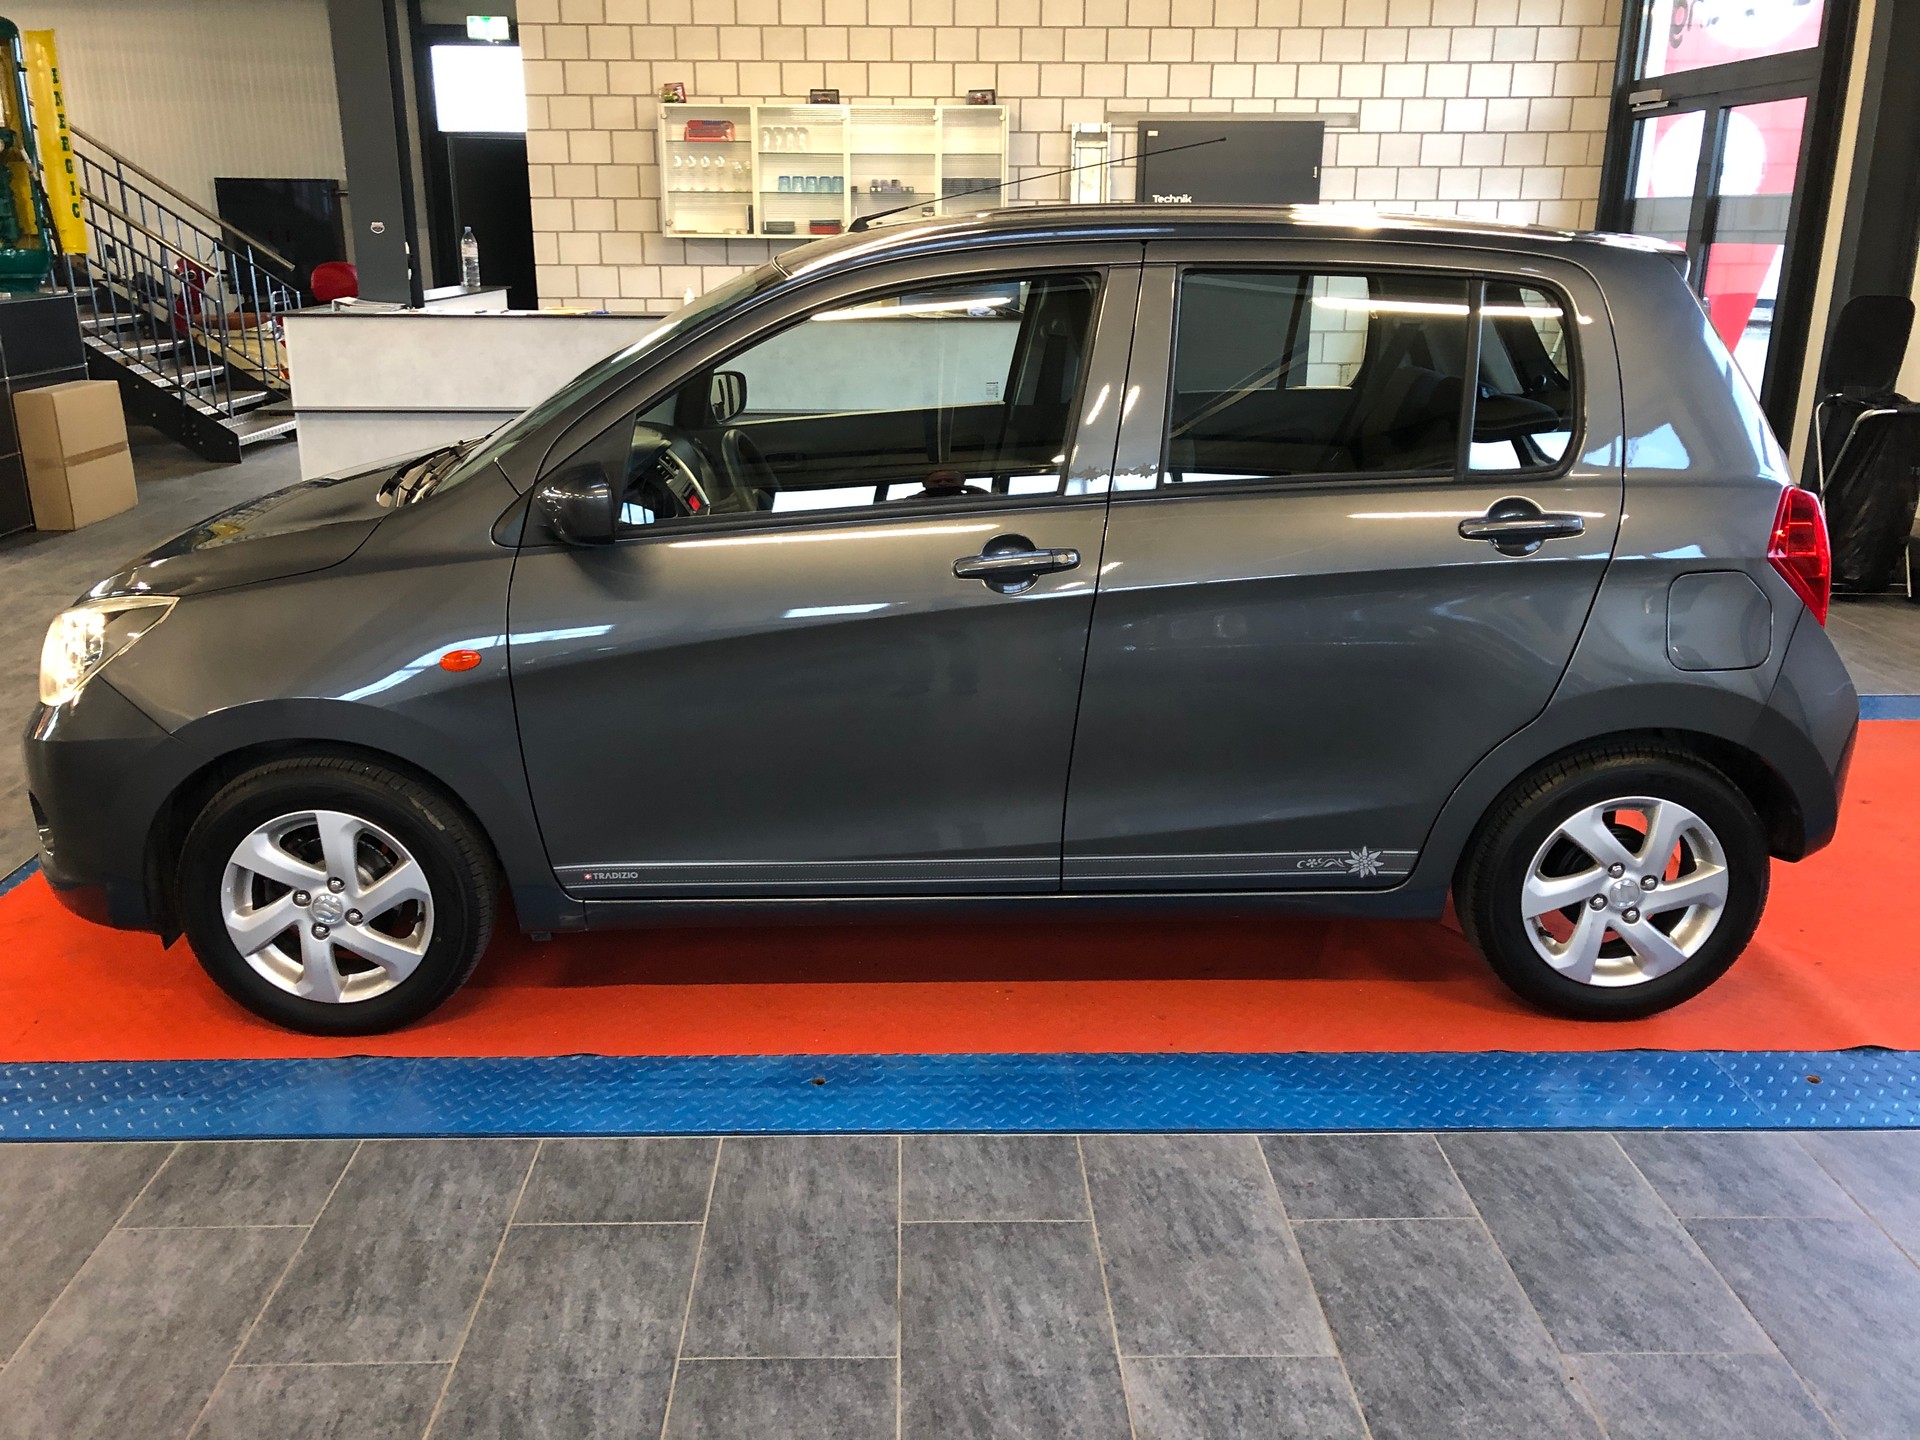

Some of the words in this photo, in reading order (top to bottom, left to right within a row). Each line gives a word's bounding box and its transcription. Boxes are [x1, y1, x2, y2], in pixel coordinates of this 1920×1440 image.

[51, 68, 80, 218] ENERGIC
[1152, 194, 1192, 203] Technik
[593, 871, 638, 879] TRADIZIO
